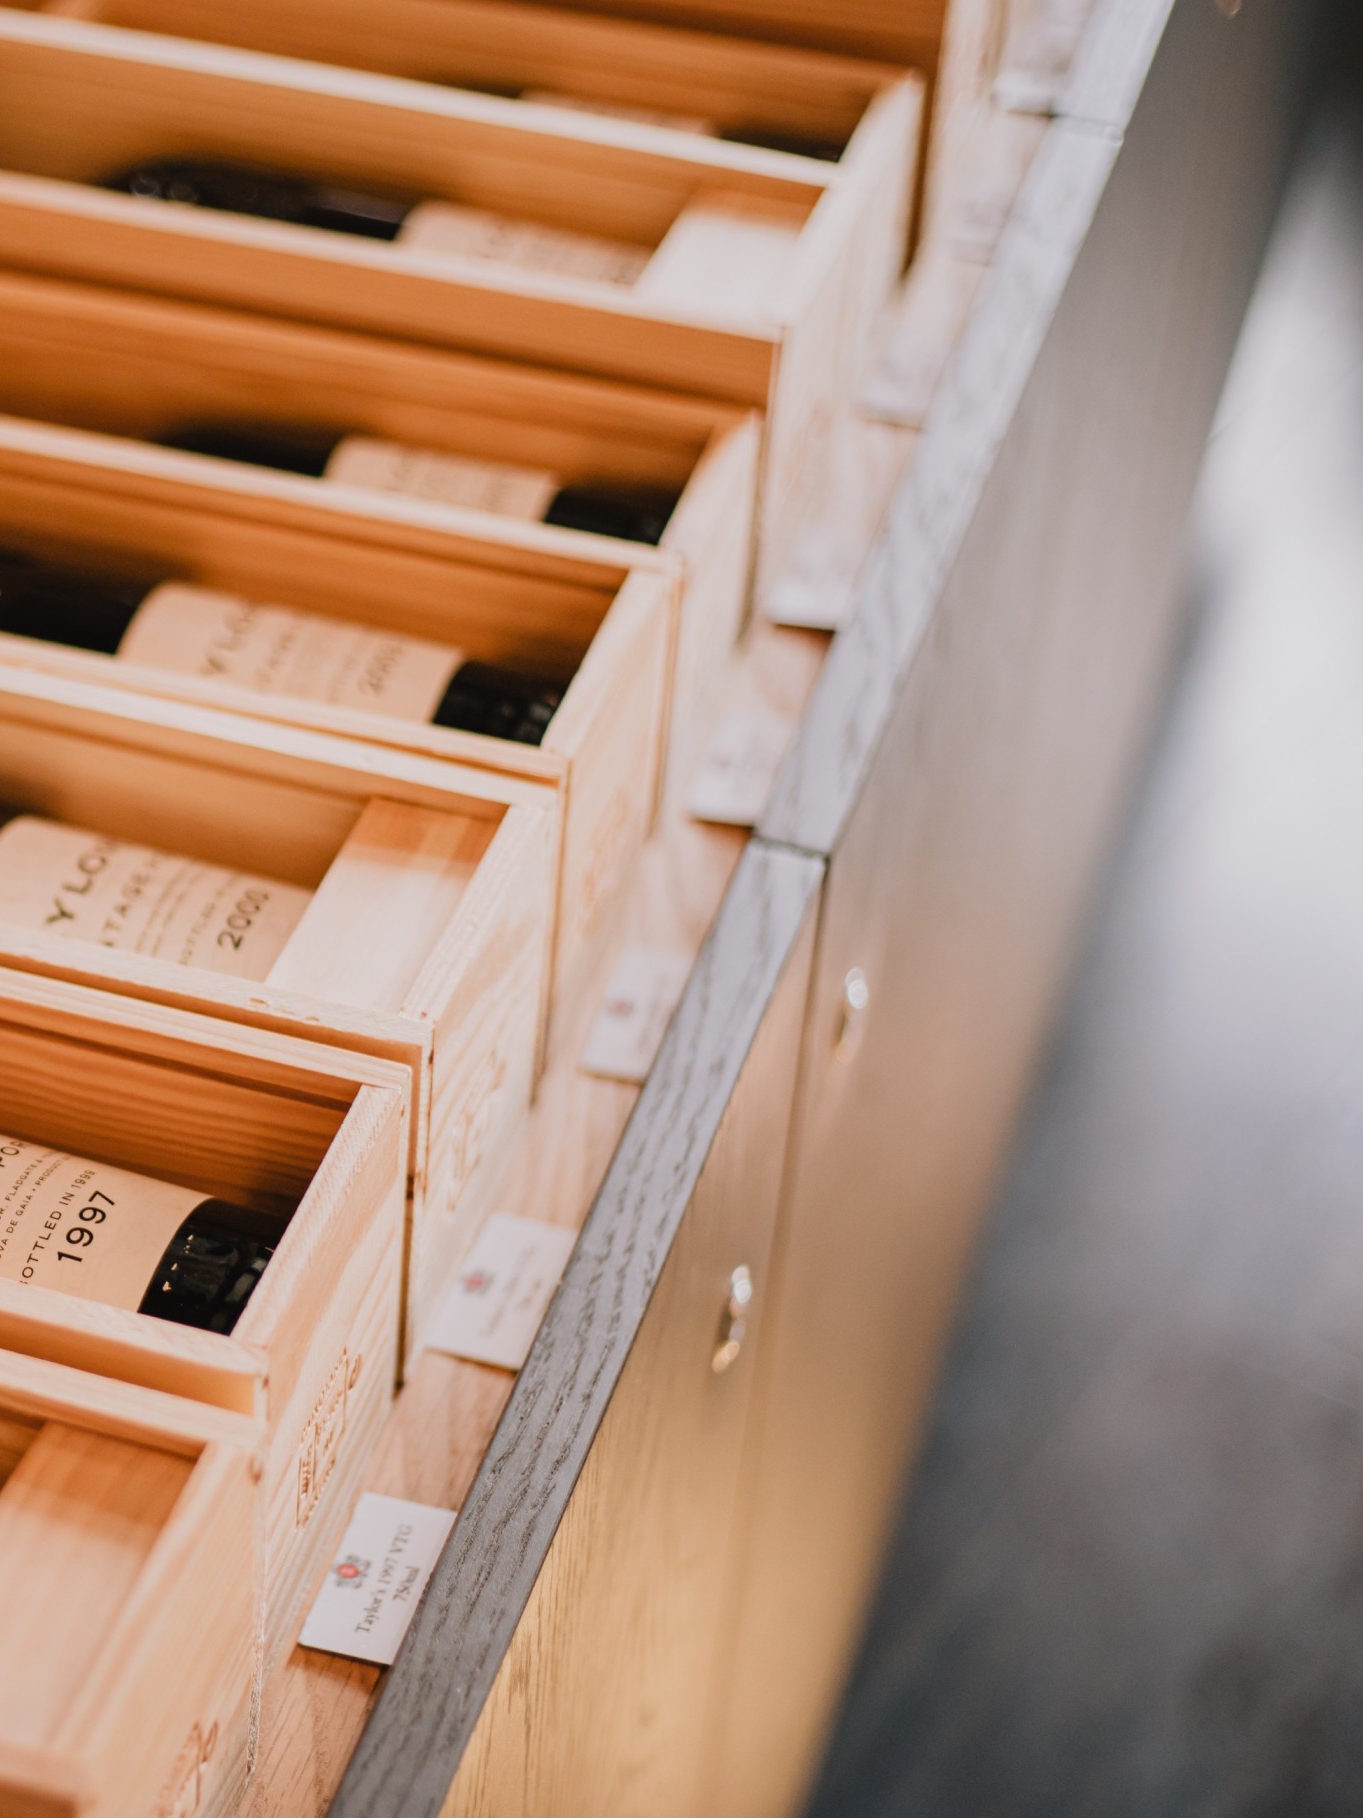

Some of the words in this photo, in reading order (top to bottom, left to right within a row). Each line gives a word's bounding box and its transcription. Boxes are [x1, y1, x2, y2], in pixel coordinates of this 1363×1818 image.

[4, 1163, 39, 1202] FLADGATE
[58, 1191, 76, 1206] IN
[5, 1219, 19, 1234] DE
[15, 1194, 34, 1217] GAIA
[56, 1189, 116, 1263] 1997
[354, 1588, 386, 1633] Taylor's
[388, 1523, 414, 1554] VTG
